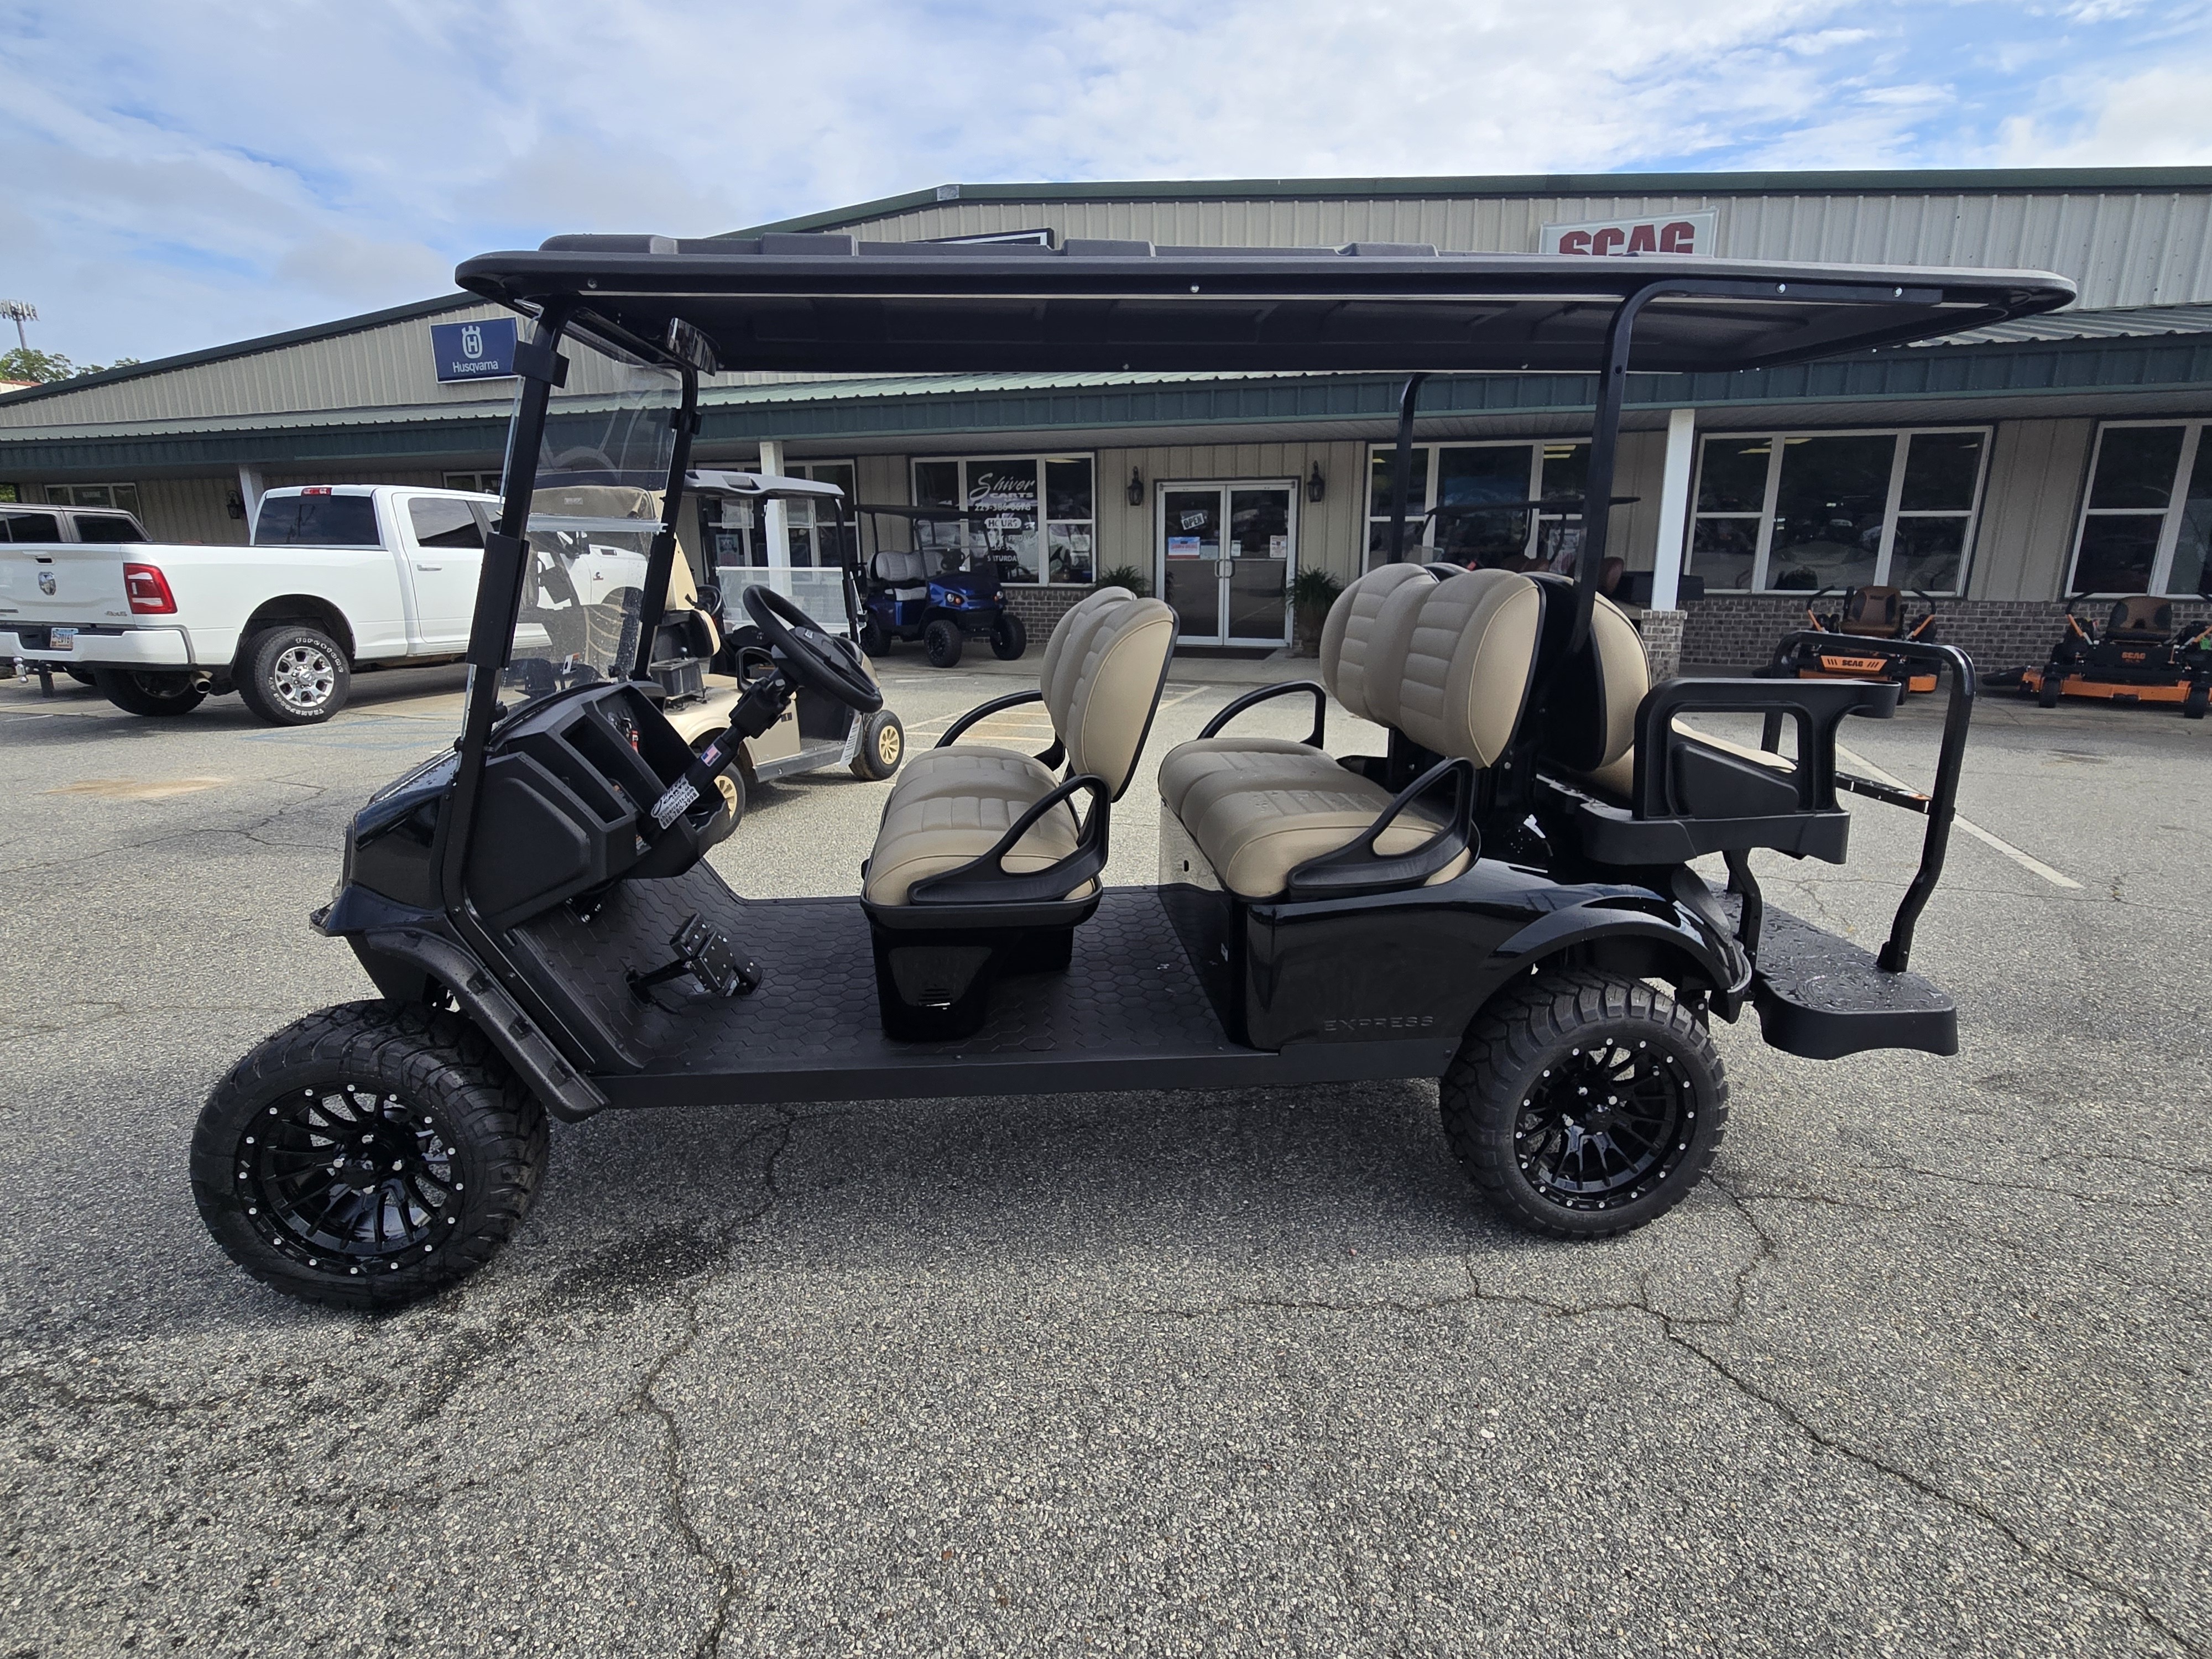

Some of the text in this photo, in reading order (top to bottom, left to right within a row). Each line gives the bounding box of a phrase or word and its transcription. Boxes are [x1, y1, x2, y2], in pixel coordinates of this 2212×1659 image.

[1559, 222, 1695, 256] SCAG
[452, 361, 499, 373] Husqvarna
[969, 472, 1035, 501] Shiver
[1184, 515, 1202, 528] OPEN
[660, 787, 695, 822] shivercarts.com
[1325, 1016, 1433, 1031] EXPRESS
